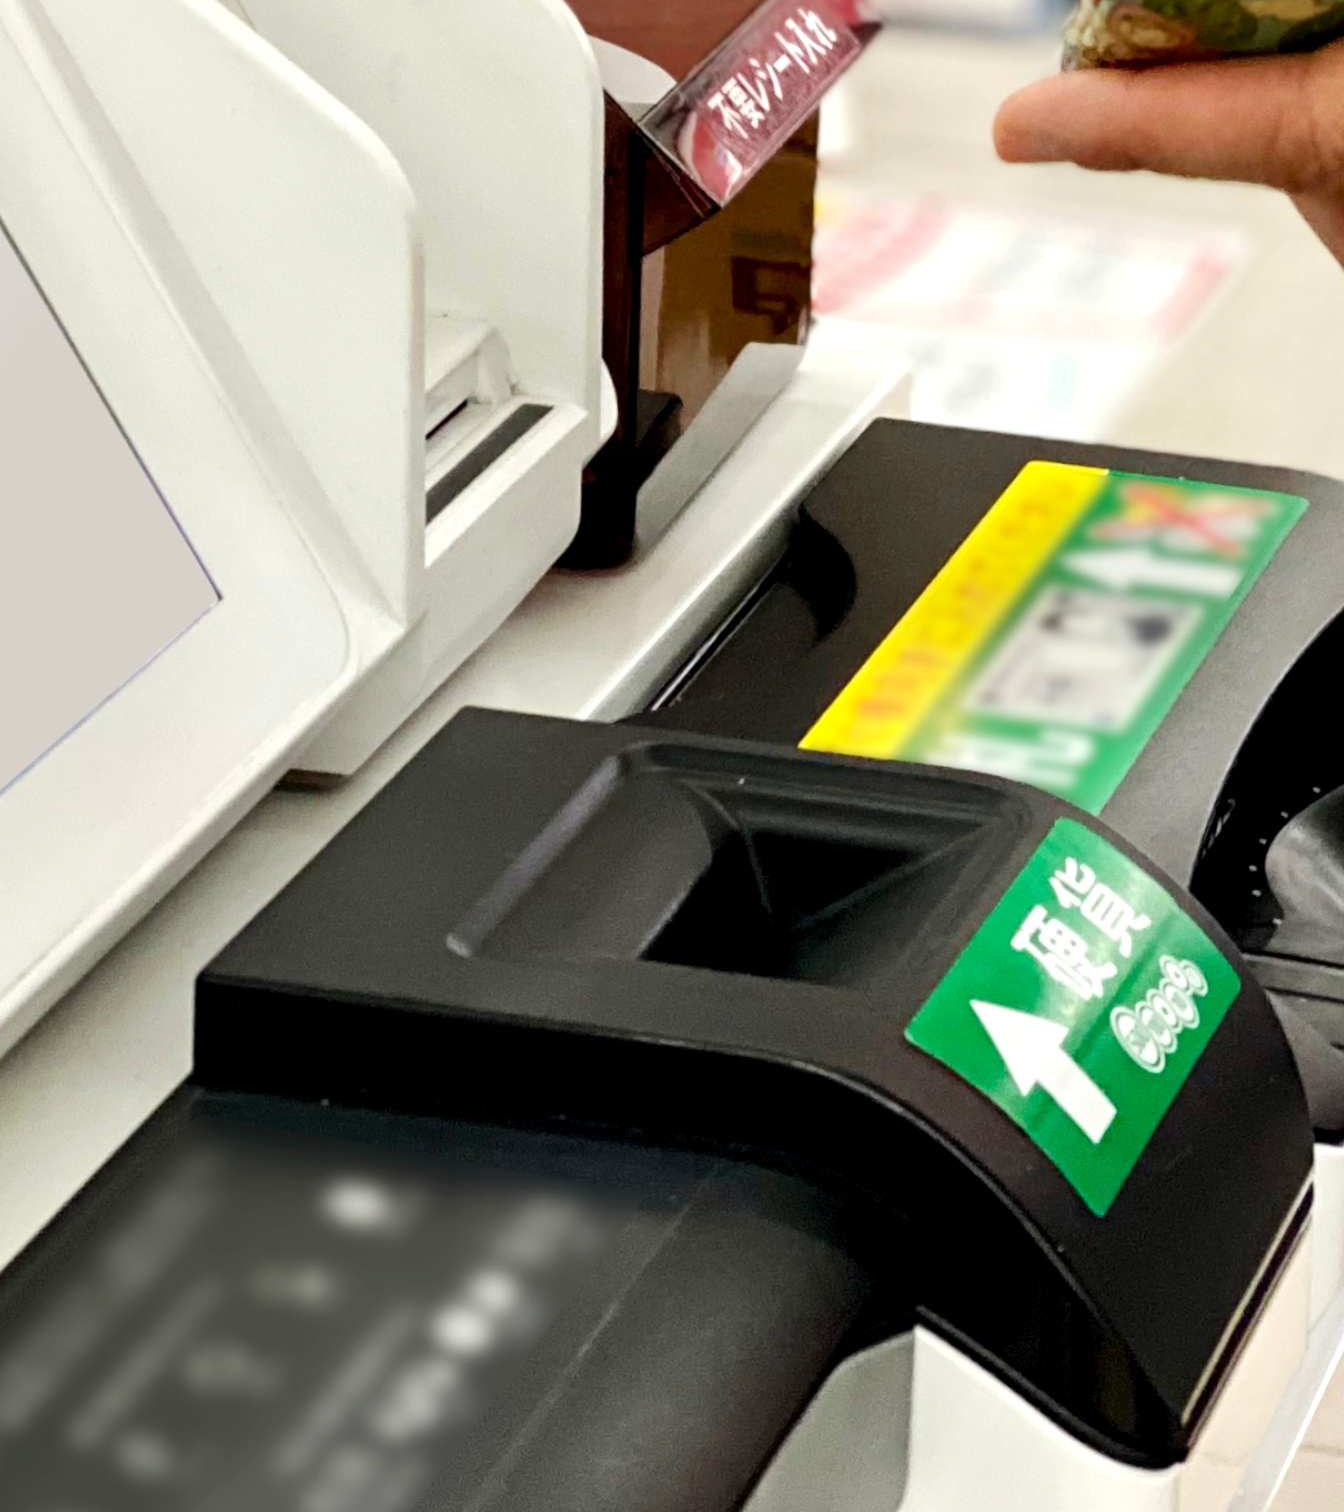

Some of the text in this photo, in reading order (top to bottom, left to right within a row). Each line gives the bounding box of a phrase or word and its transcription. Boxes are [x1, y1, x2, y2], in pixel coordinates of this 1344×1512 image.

[708, 8, 837, 139] 不要レシート入れ
[1010, 856, 1152, 998] 硬貨
